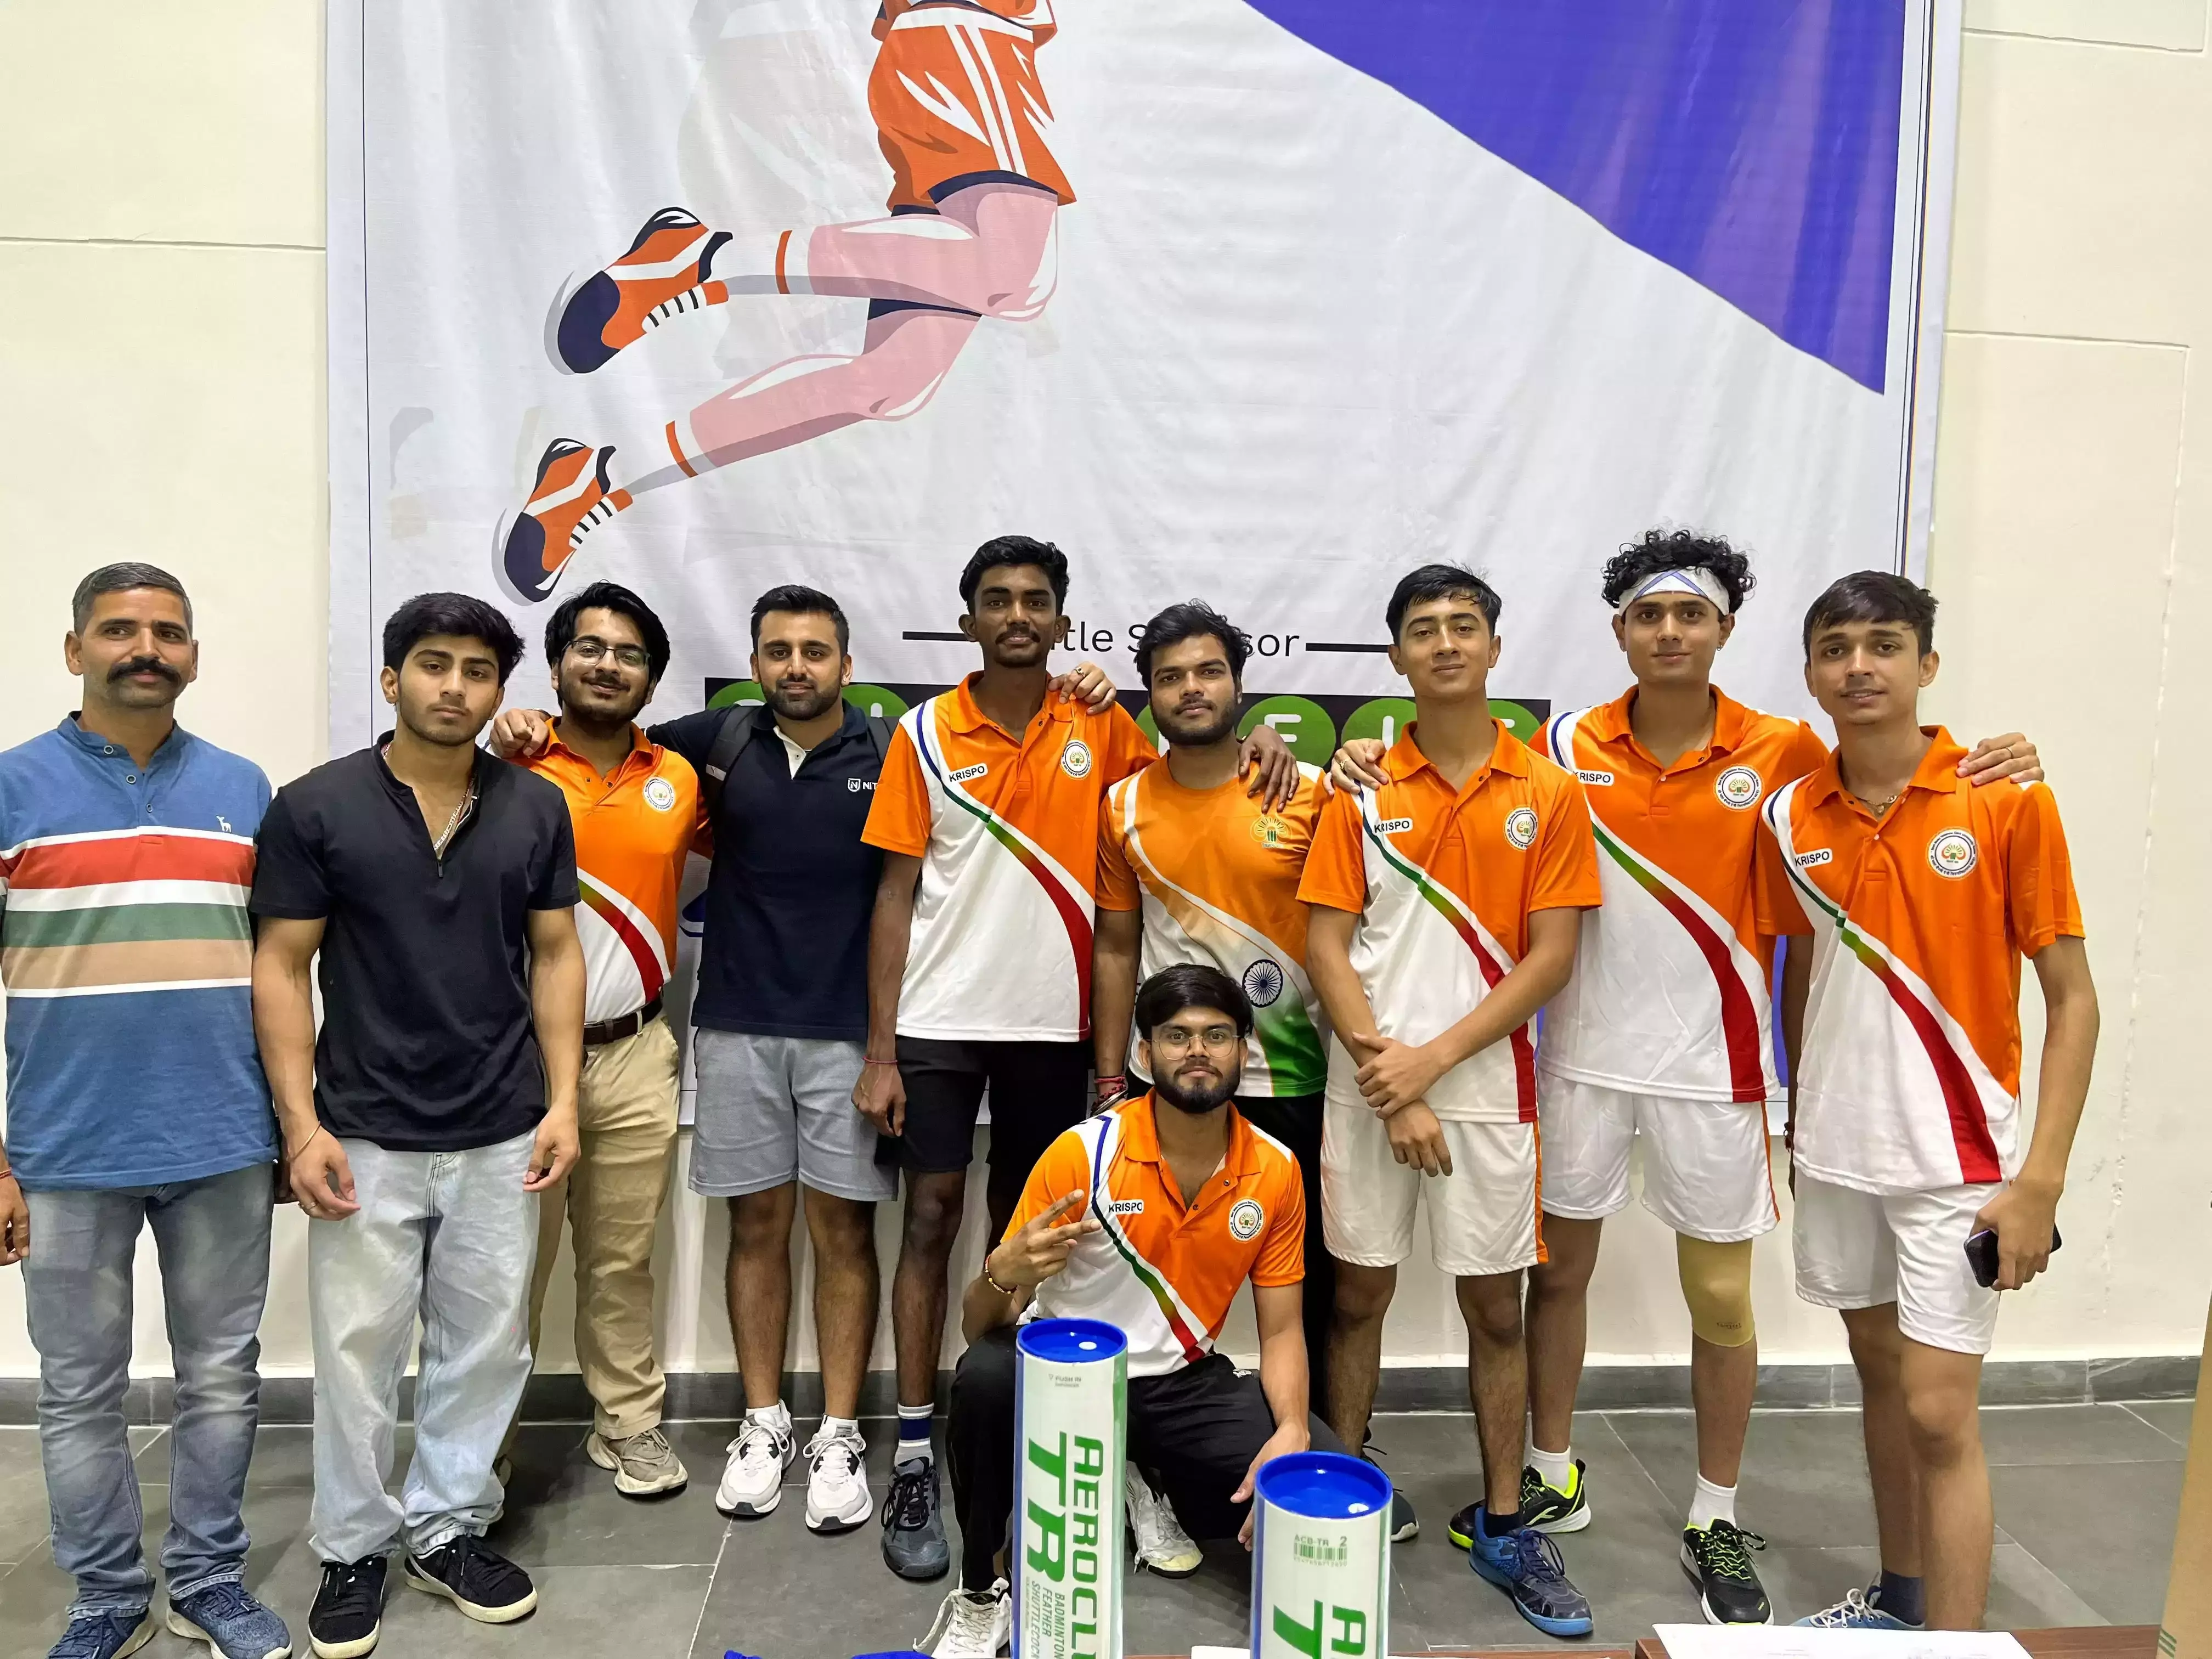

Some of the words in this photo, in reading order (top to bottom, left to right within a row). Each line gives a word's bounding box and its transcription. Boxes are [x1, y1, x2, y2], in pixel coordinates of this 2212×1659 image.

[949, 766, 985, 782] KRISPO
[1374, 821, 1409, 833] KRISPO
[1795, 851, 1830, 866] KRISPO
[1027, 1431, 1066, 1582] TR
[1071, 1435, 1103, 1659] AEROCL
[1340, 1536, 1347, 1547] 2
[1042, 1587, 1052, 1637] FEATHER
